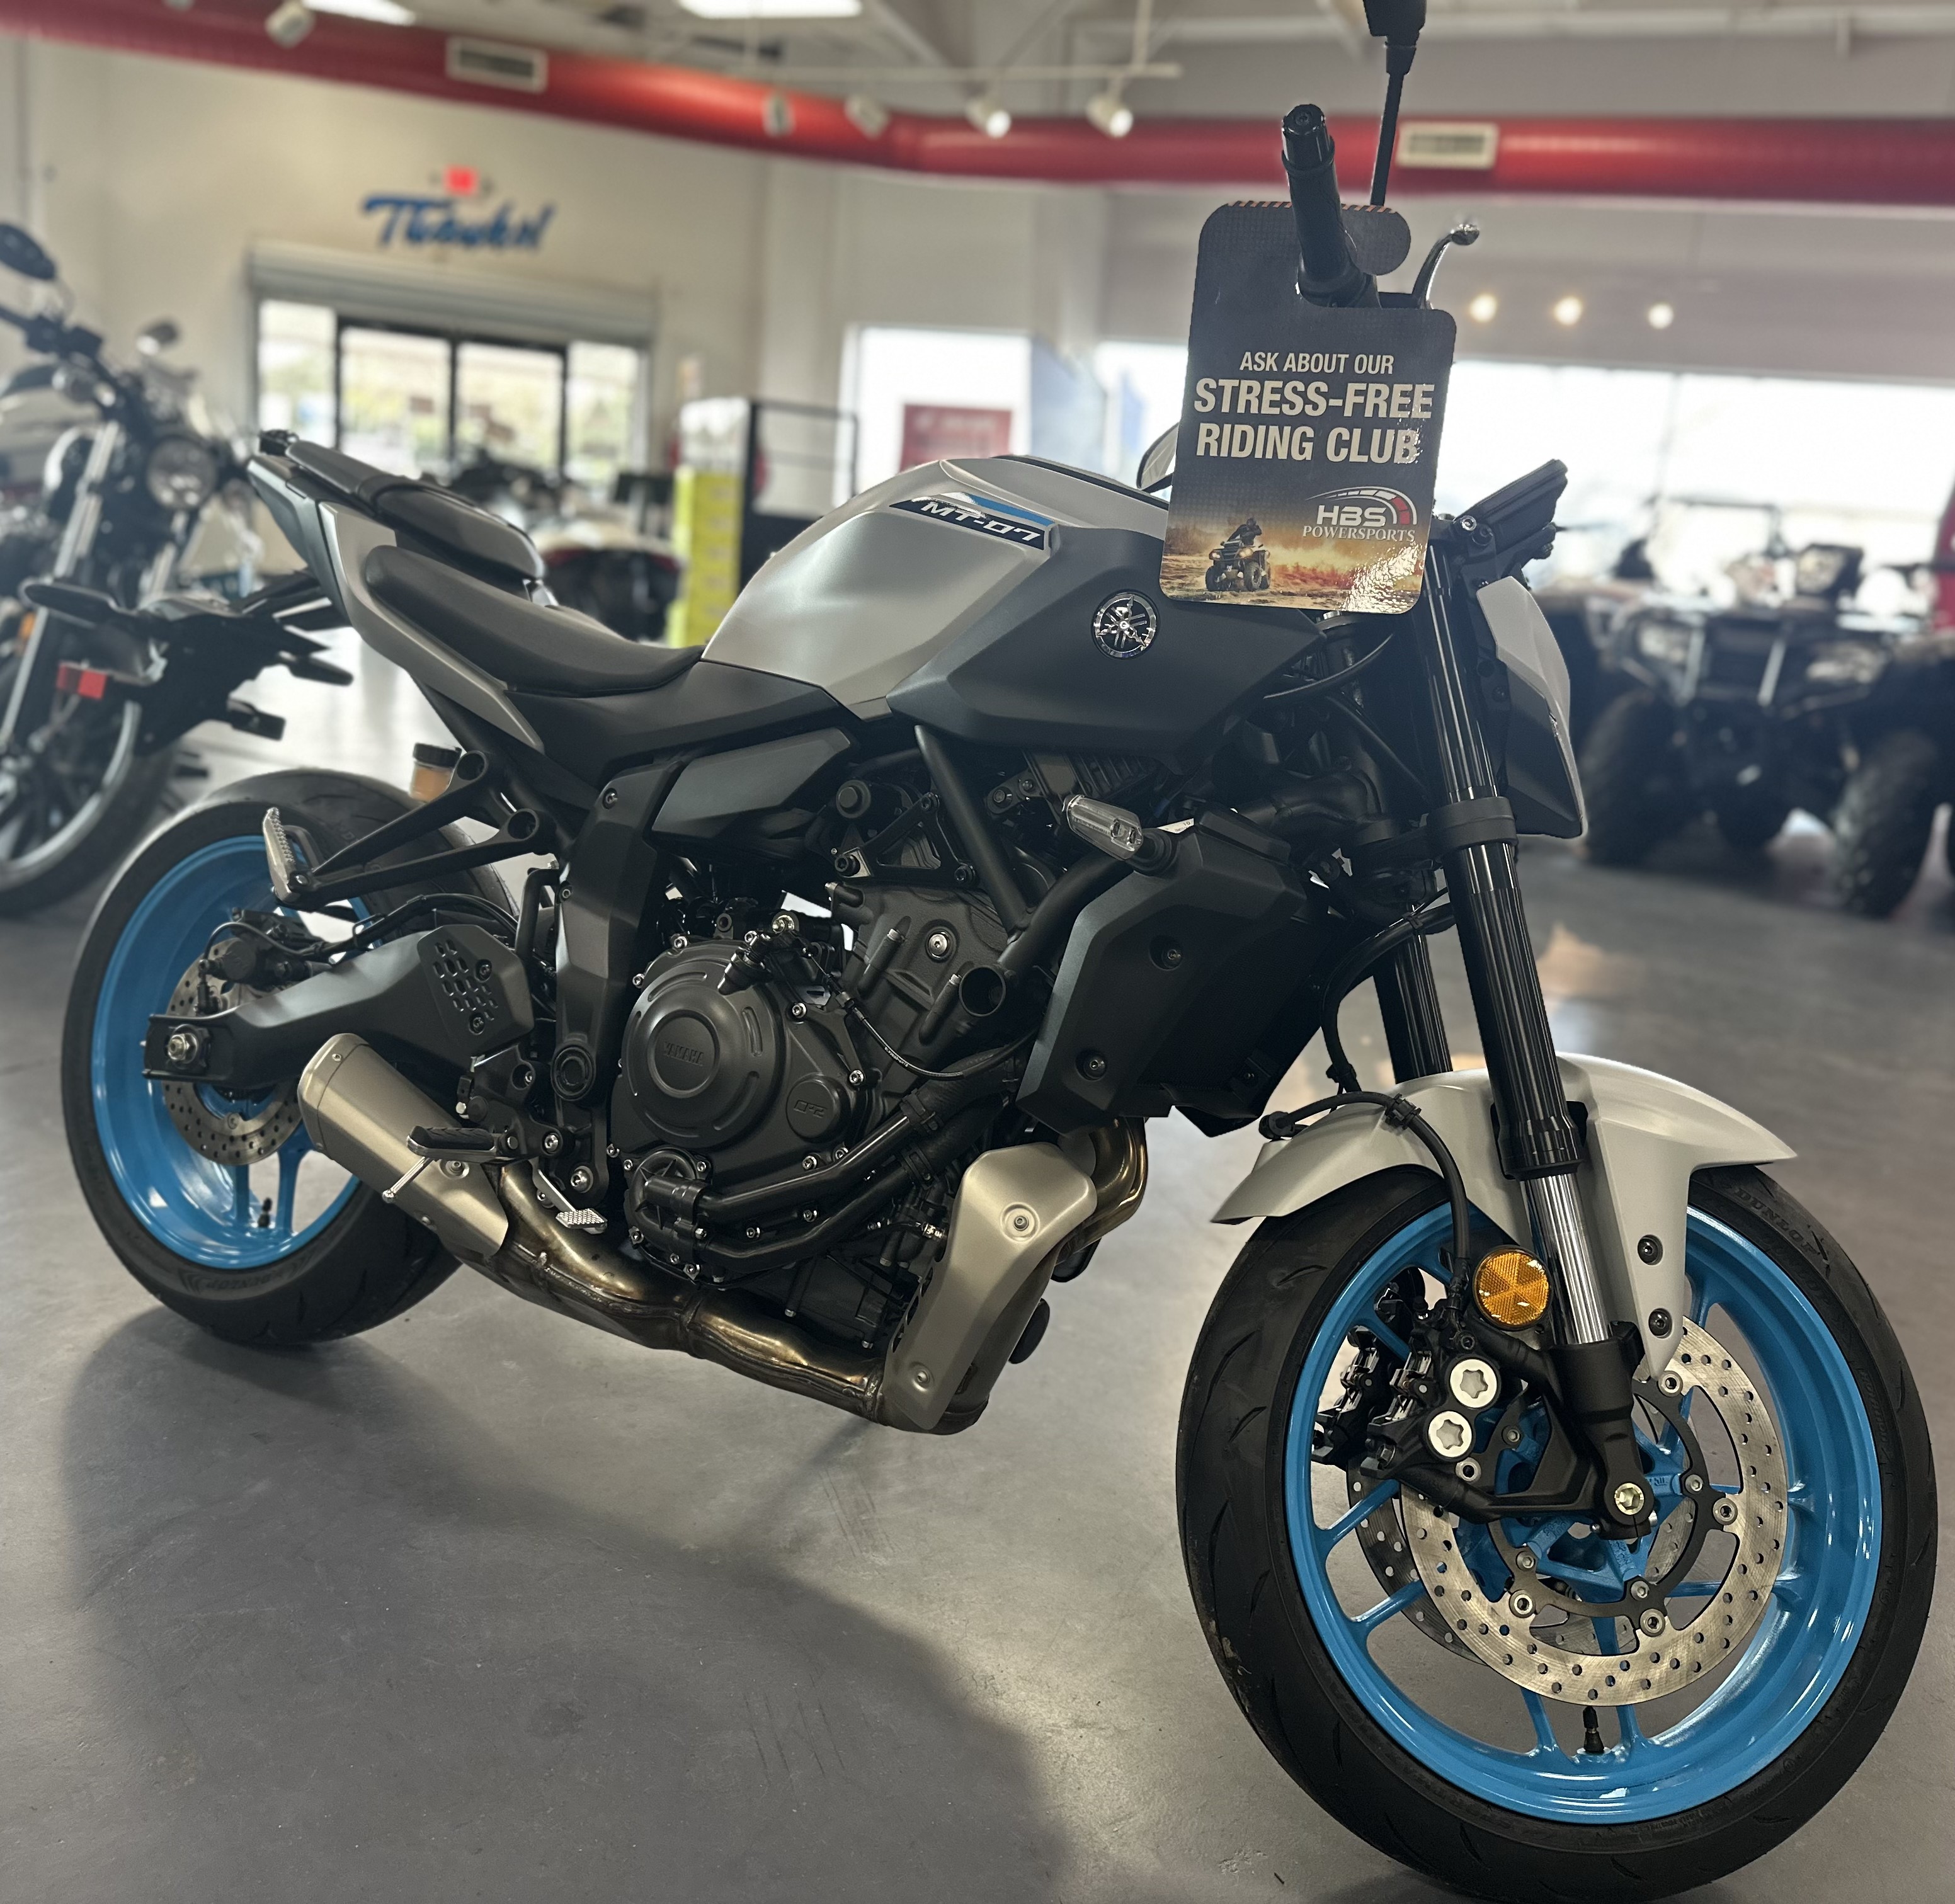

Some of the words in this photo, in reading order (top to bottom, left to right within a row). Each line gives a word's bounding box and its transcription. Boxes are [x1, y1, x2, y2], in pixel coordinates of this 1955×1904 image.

[1240, 351, 1279, 372] ASK
[1283, 353, 1349, 373] ABOUT
[1354, 354, 1394, 375] OUR
[1194, 378, 1435, 419] STRESS-FREE
[1197, 423, 1314, 460] RIDING
[1326, 427, 1421, 464] CLUB
[921, 501, 1041, 542] MT-07
[1316, 505, 1386, 527] HBS
[1302, 525, 1415, 542] POWERSPORTS
[664, 1042, 704, 1067] YAMAHA
[1734, 1187, 1820, 1257] DUNLOP
[208, 1275, 270, 1289] DUNLOP
